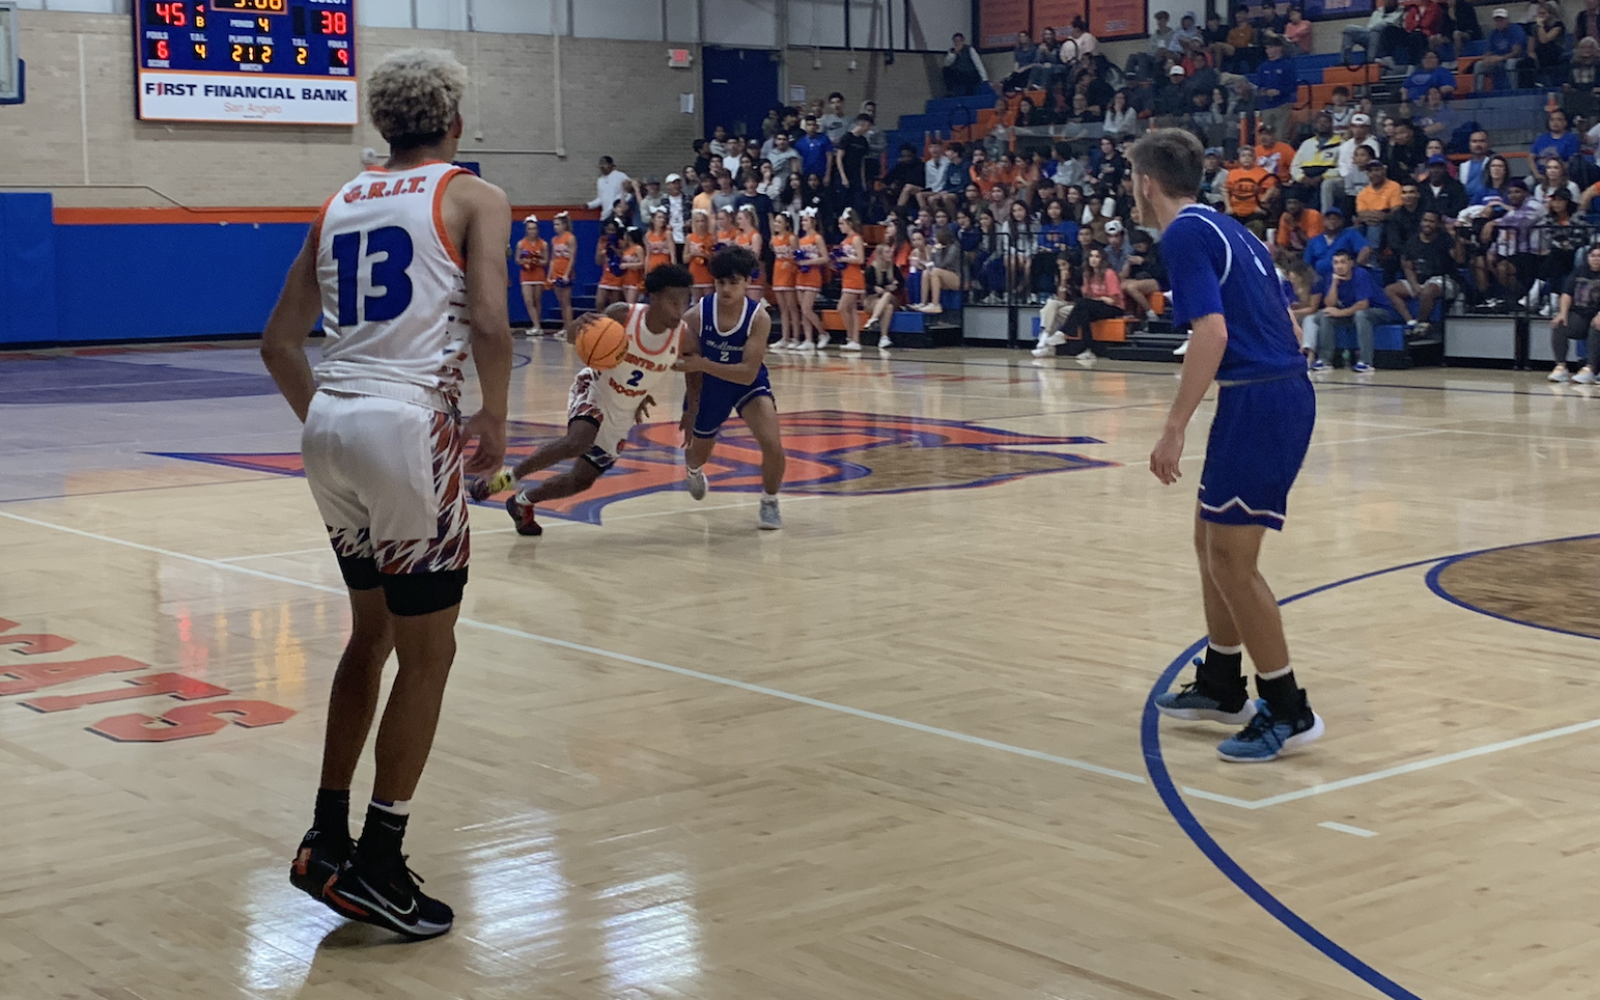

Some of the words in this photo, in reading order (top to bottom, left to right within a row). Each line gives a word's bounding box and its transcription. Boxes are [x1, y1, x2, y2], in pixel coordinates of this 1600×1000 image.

[156, 2, 186, 26] 45
[321, 11, 346, 34] 38
[258, 17, 269, 32] 4
[157, 40, 169, 59] 6
[194, 44, 206, 59] 4
[296, 47, 308, 65] 2
[337, 48, 349, 65] 9
[145, 82, 198, 97] FIRST
[204, 85, 296, 100] FINANCIAL
[302, 88, 348, 102] BANK
[332, 225, 414, 328] 13
[719, 351, 730, 362] 2
[626, 370, 644, 387] 2
